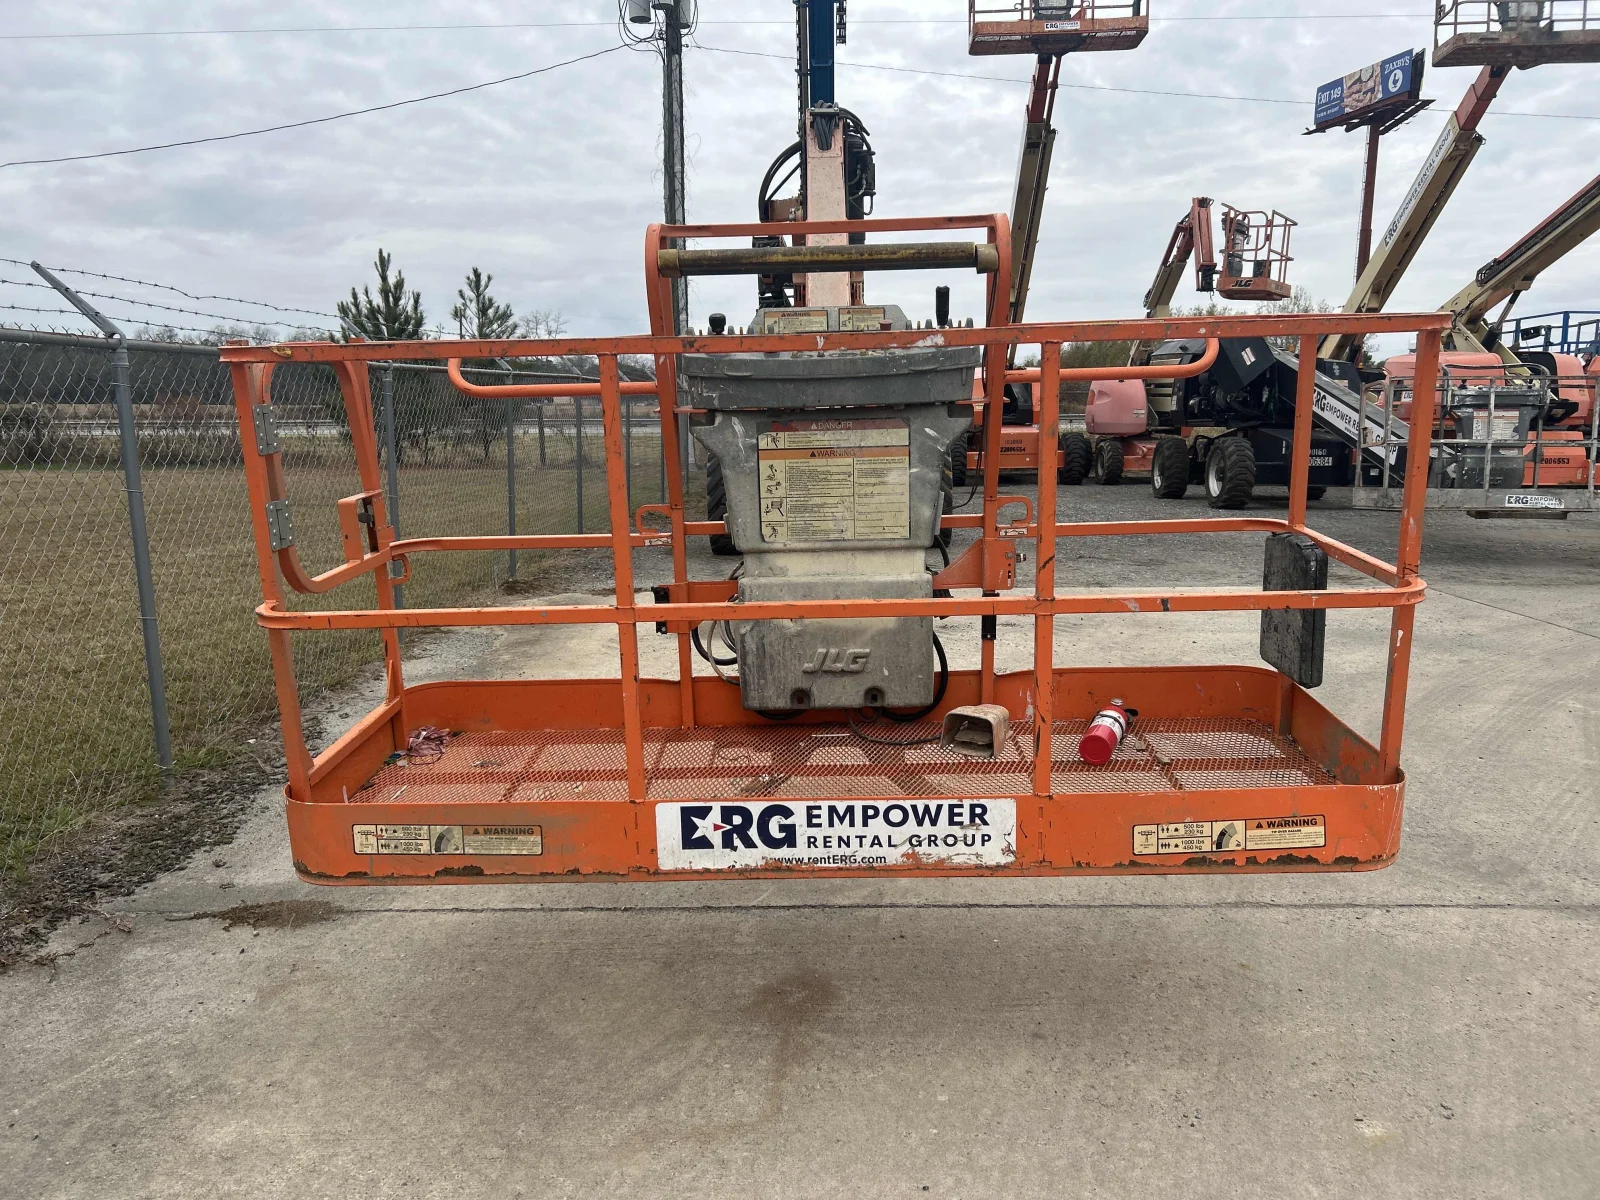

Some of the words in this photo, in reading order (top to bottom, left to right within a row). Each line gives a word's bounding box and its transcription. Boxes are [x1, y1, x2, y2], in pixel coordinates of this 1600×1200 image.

[1385, 56, 1410, 74] ZAXBY'S
[1318, 91, 1330, 105] EXIT
[1331, 87, 1341, 99] 149
[1327, 106, 1339, 115] RIGHT
[1397, 187, 1418, 225] EMPOWER
[1417, 158, 1436, 188] RENTAL
[1435, 128, 1452, 158] GROUP
[1231, 279, 1253, 288] JLG
[1312, 389, 1327, 413] RG
[1325, 402, 1352, 426] EMPOWER
[818, 421, 853, 430] DANGER
[816, 449, 856, 458] WARNING
[1507, 495, 1528, 504] ERG
[802, 648, 870, 674] JLG
[680, 804, 797, 850] ERG
[806, 803, 990, 829] EMPOWER
[1267, 818, 1318, 829] WARNING
[483, 827, 535, 836] WARNING
[807, 834, 897, 849] RENTAL
[908, 833, 993, 848] GROUP
[773, 854, 887, 865] www.rentERG.com
